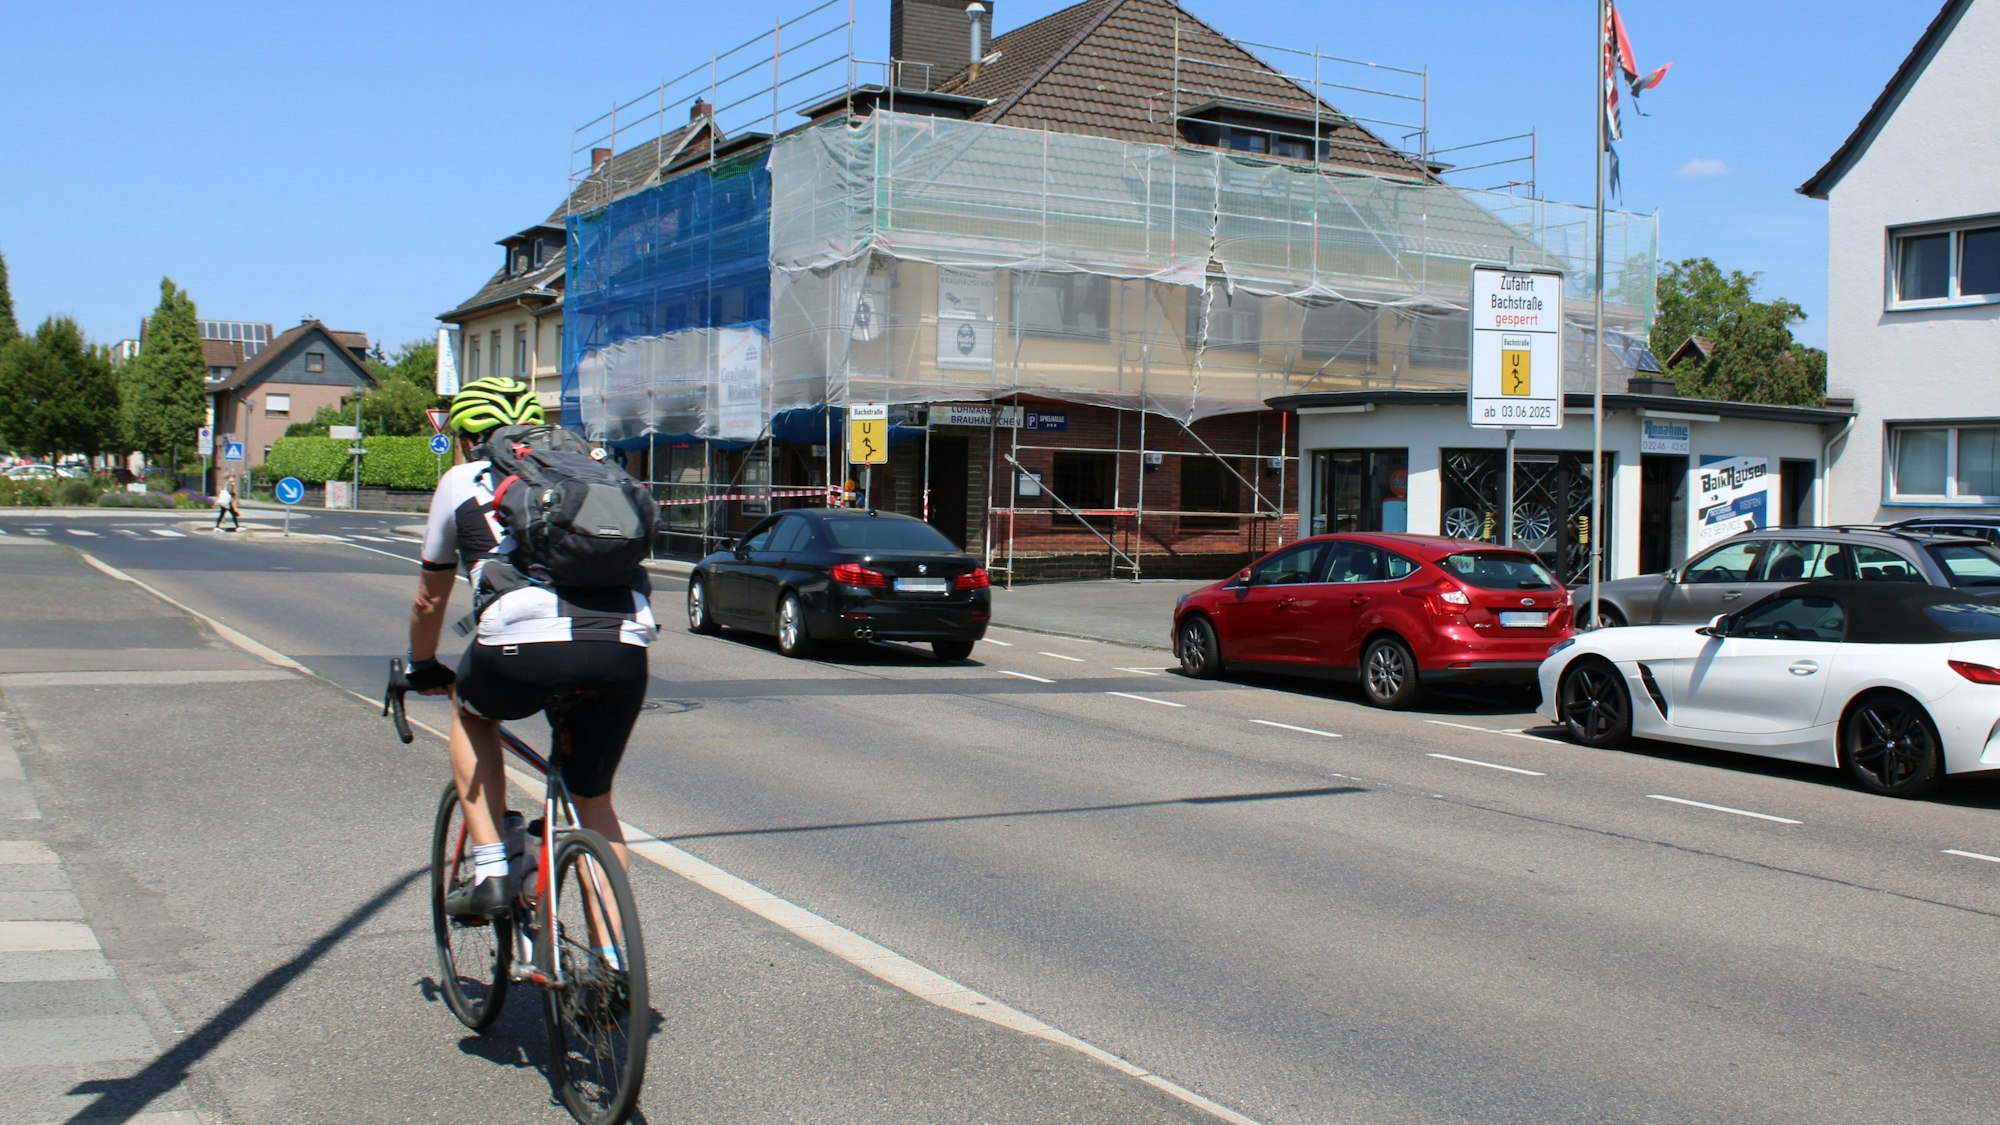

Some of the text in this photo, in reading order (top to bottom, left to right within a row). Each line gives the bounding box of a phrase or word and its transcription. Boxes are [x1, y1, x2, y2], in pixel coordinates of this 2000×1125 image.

[1500, 276, 1534, 292] Zufahrt
[1491, 295, 1543, 311] Bachstraße
[1495, 313, 1539, 328] gesperrt
[1503, 337, 1530, 347] Bachstraße
[1512, 354, 1520, 367] U
[854, 408, 883, 416] Bachstraße
[950, 406, 994, 415] LOHMARE
[1484, 406, 1551, 418] ab 03.06.2025
[950, 415, 1021, 427] BRAUHÄUCHEN
[1039, 415, 1065, 423] SPIELHALLE
[863, 422, 871, 434] U
